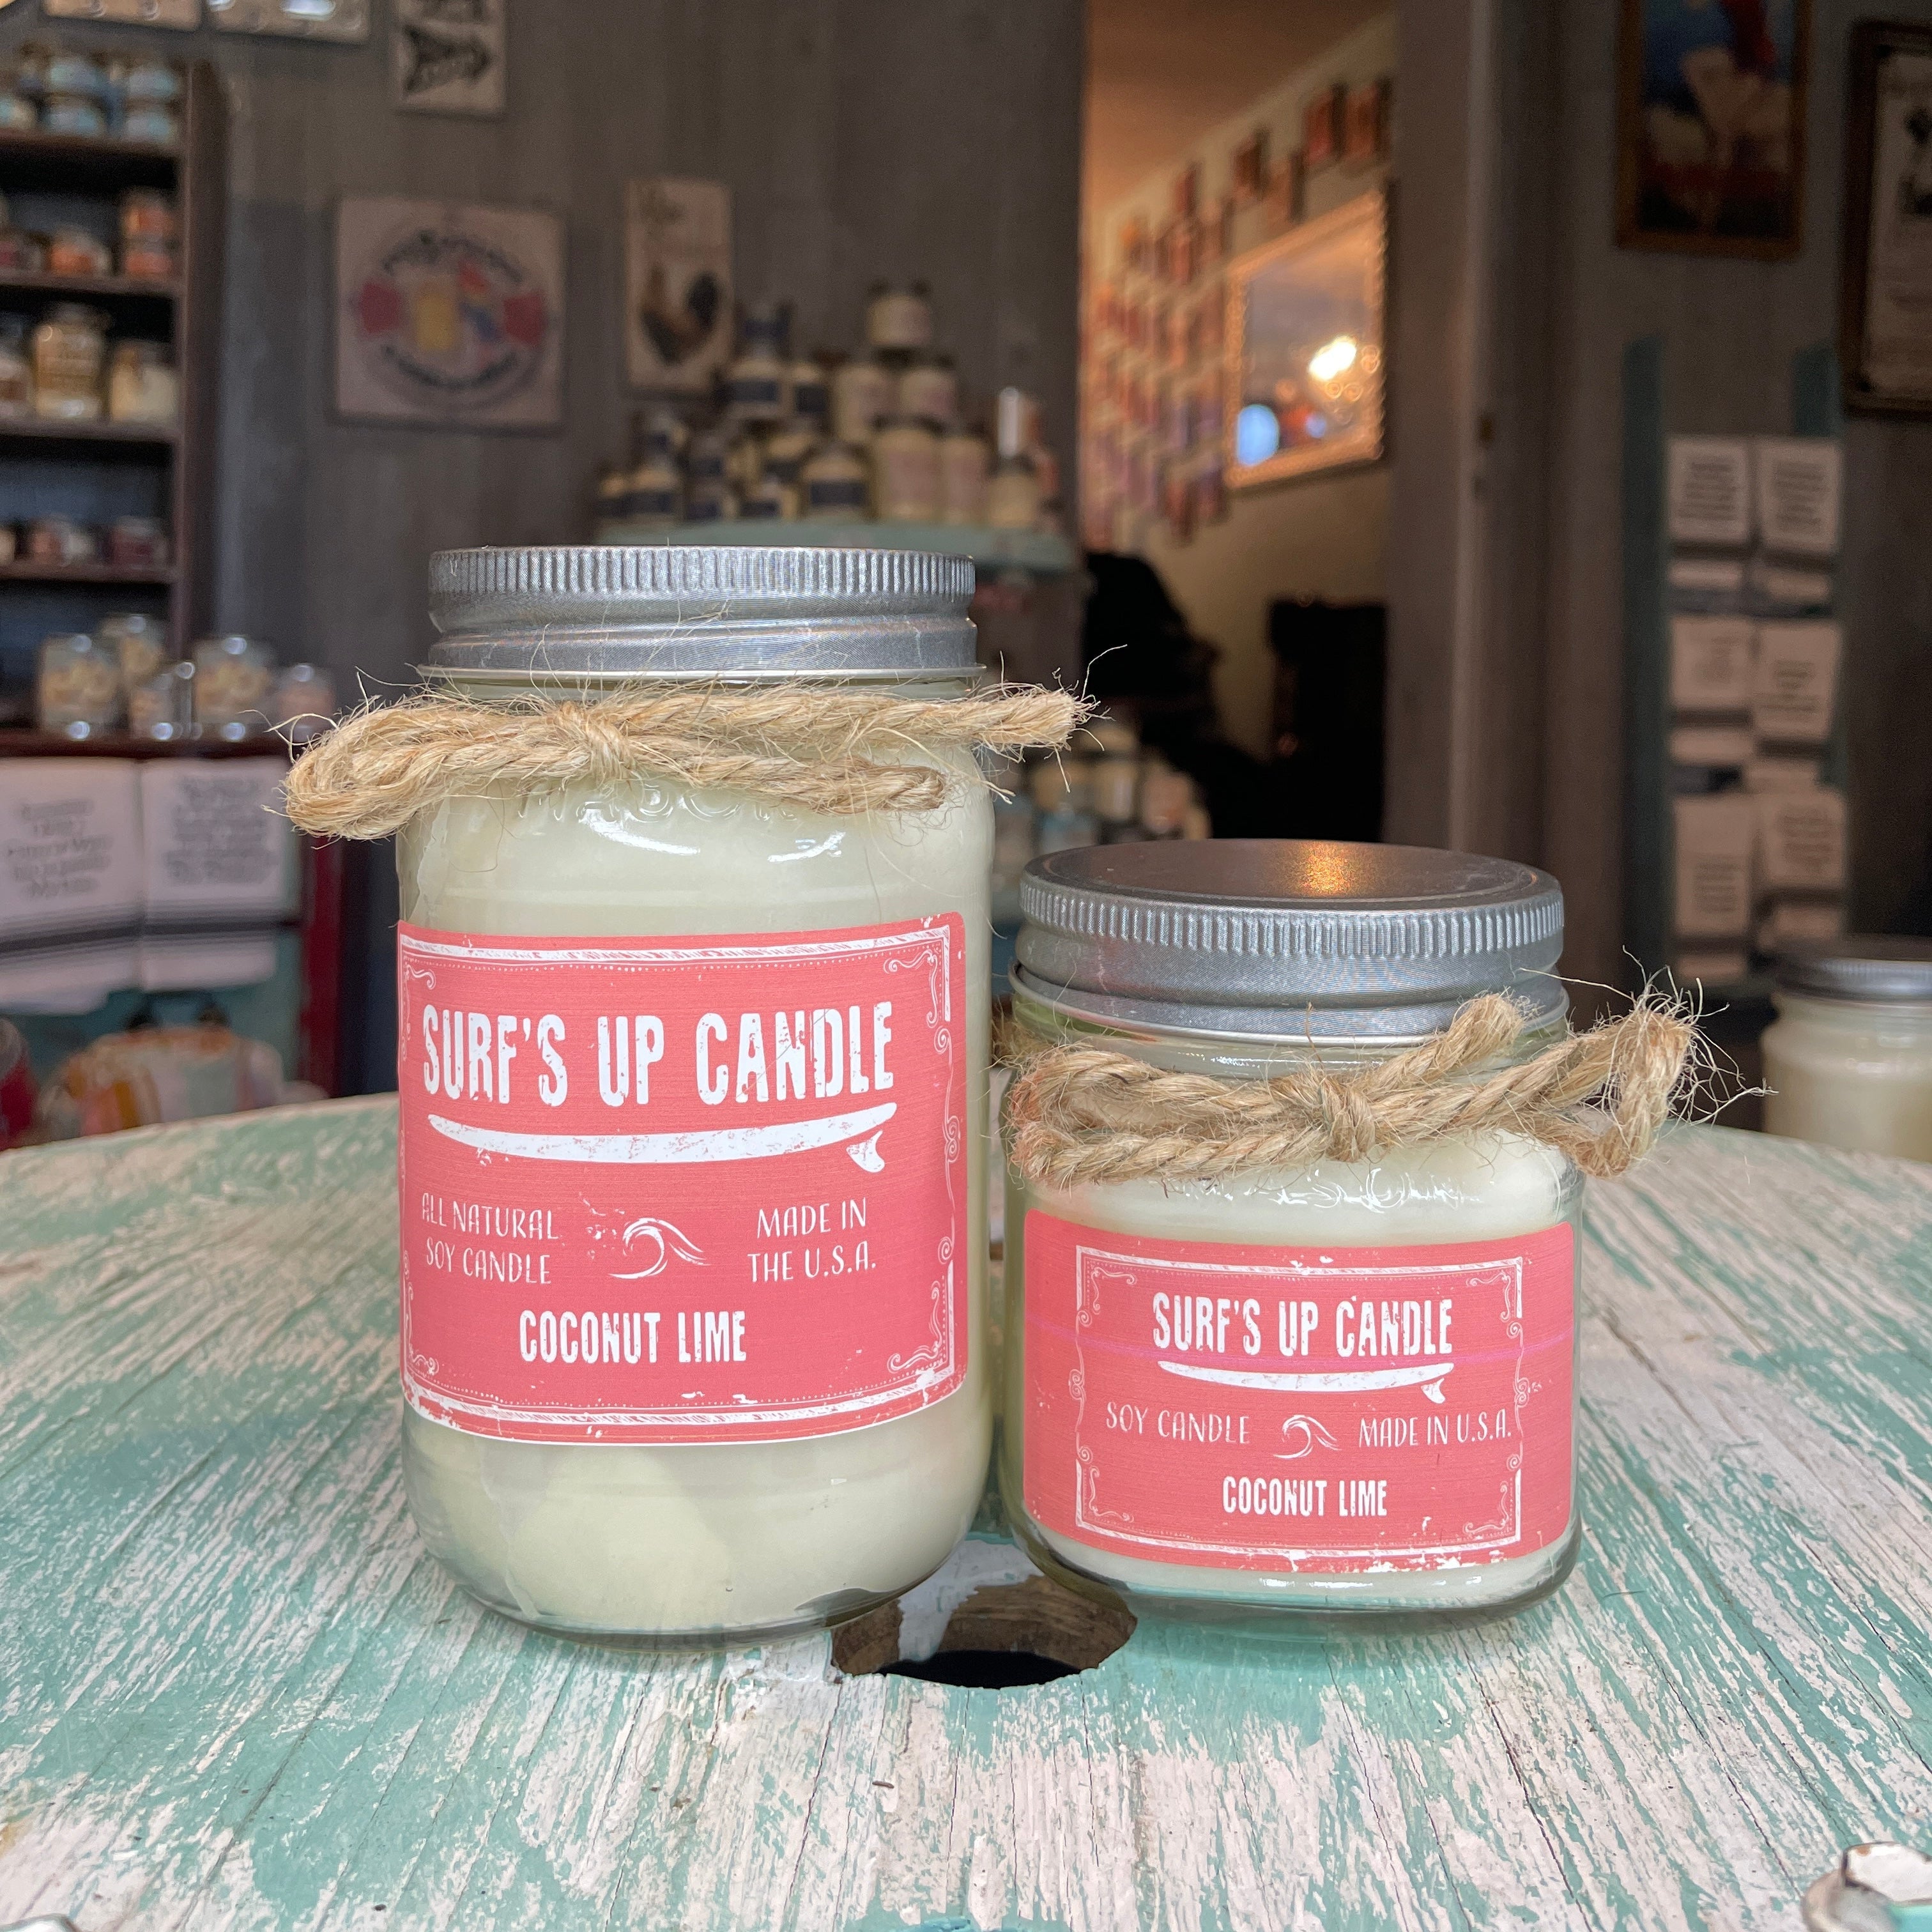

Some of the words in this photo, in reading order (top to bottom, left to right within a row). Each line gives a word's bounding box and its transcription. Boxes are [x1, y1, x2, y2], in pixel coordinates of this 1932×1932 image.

[424, 1005, 567, 1107] SURF'S
[598, 1016, 664, 1107] UP
[696, 1002, 893, 1105] CANDLE
[422, 1193, 447, 1226] ALL
[454, 1201, 559, 1239] NATURAL
[758, 1204, 831, 1238] MADE
[842, 1197, 866, 1229] IN
[427, 1238, 455, 1272] SOY
[463, 1248, 550, 1284] CANDLE
[747, 1252, 793, 1282] THE
[805, 1241, 875, 1278] U.S.A.
[520, 1310, 660, 1363] COCONUT
[678, 1311, 746, 1362] LIME
[1153, 1292, 1261, 1355] SURF'S
[1279, 1301, 1318, 1356] UP
[1337, 1300, 1452, 1357] CANDLE
[1107, 1402, 1147, 1434] SOY
[1158, 1410, 1248, 1443] CANDLE
[1360, 1418, 1418, 1447] MADE
[1428, 1416, 1448, 1445] IN
[1457, 1409, 1512, 1443] U.S.A.
[1223, 1476, 1327, 1516] COCONUT
[1340, 1480, 1386, 1517] LIME
